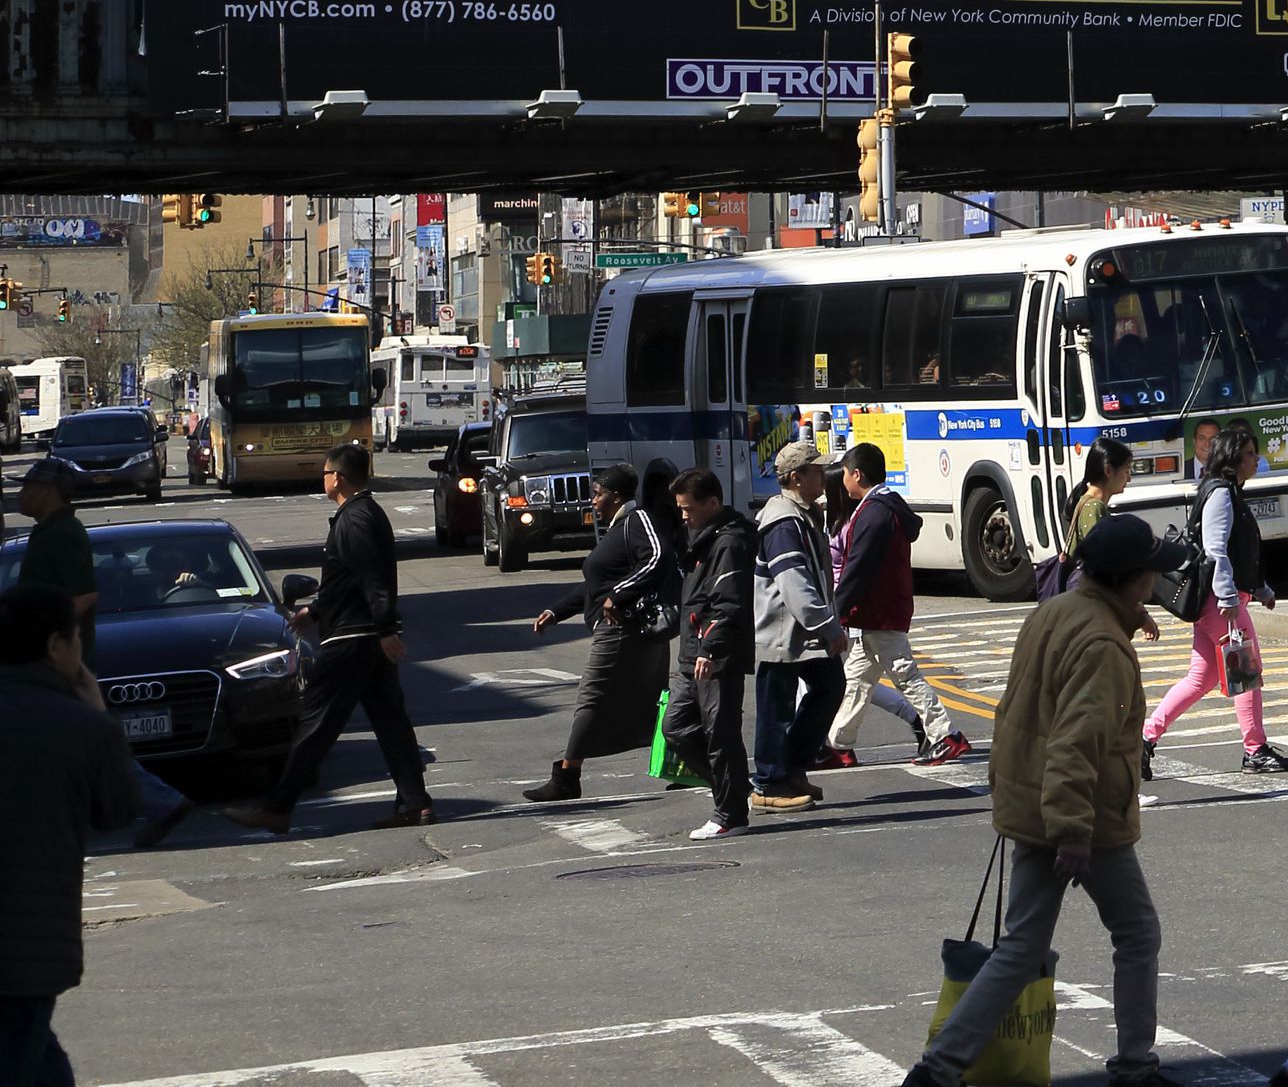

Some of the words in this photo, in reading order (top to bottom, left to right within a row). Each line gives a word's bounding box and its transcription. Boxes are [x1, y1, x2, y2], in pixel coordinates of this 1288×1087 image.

[223, 0, 376, 23] myNYCB.com
[401, 0, 457, 23] (877)
[462, 3, 557, 23] 786-6560
[809, 10, 822, 24] A
[827, 9, 883, 24] Division
[890, 10, 905, 24] of
[911, 11, 944, 25] New
[950, 10, 985, 25] York
[989, 10, 1080, 30] Community
[1084, 12, 1121, 27] Bank
[1138, 13, 1202, 28] Member
[1206, 15, 1244, 29] FDIC
[675, 62, 890, 96] OUTFRONT
[720, 198, 745, 214] at&t
[574, 254, 585, 262] NO
[605, 256, 662, 266] Roosevelt
[664, 255, 680, 265] Av
[568, 263, 589, 271] TURNS
[948, 419, 957, 430] New
[957, 419, 968, 430] York
[968, 419, 976, 431] City
[976, 419, 985, 430] Bus
[990, 418, 1001, 429] 5158
[1259, 416, 1285, 428] Good
[1102, 427, 1128, 439] 5158
[1262, 425, 1278, 435] New
